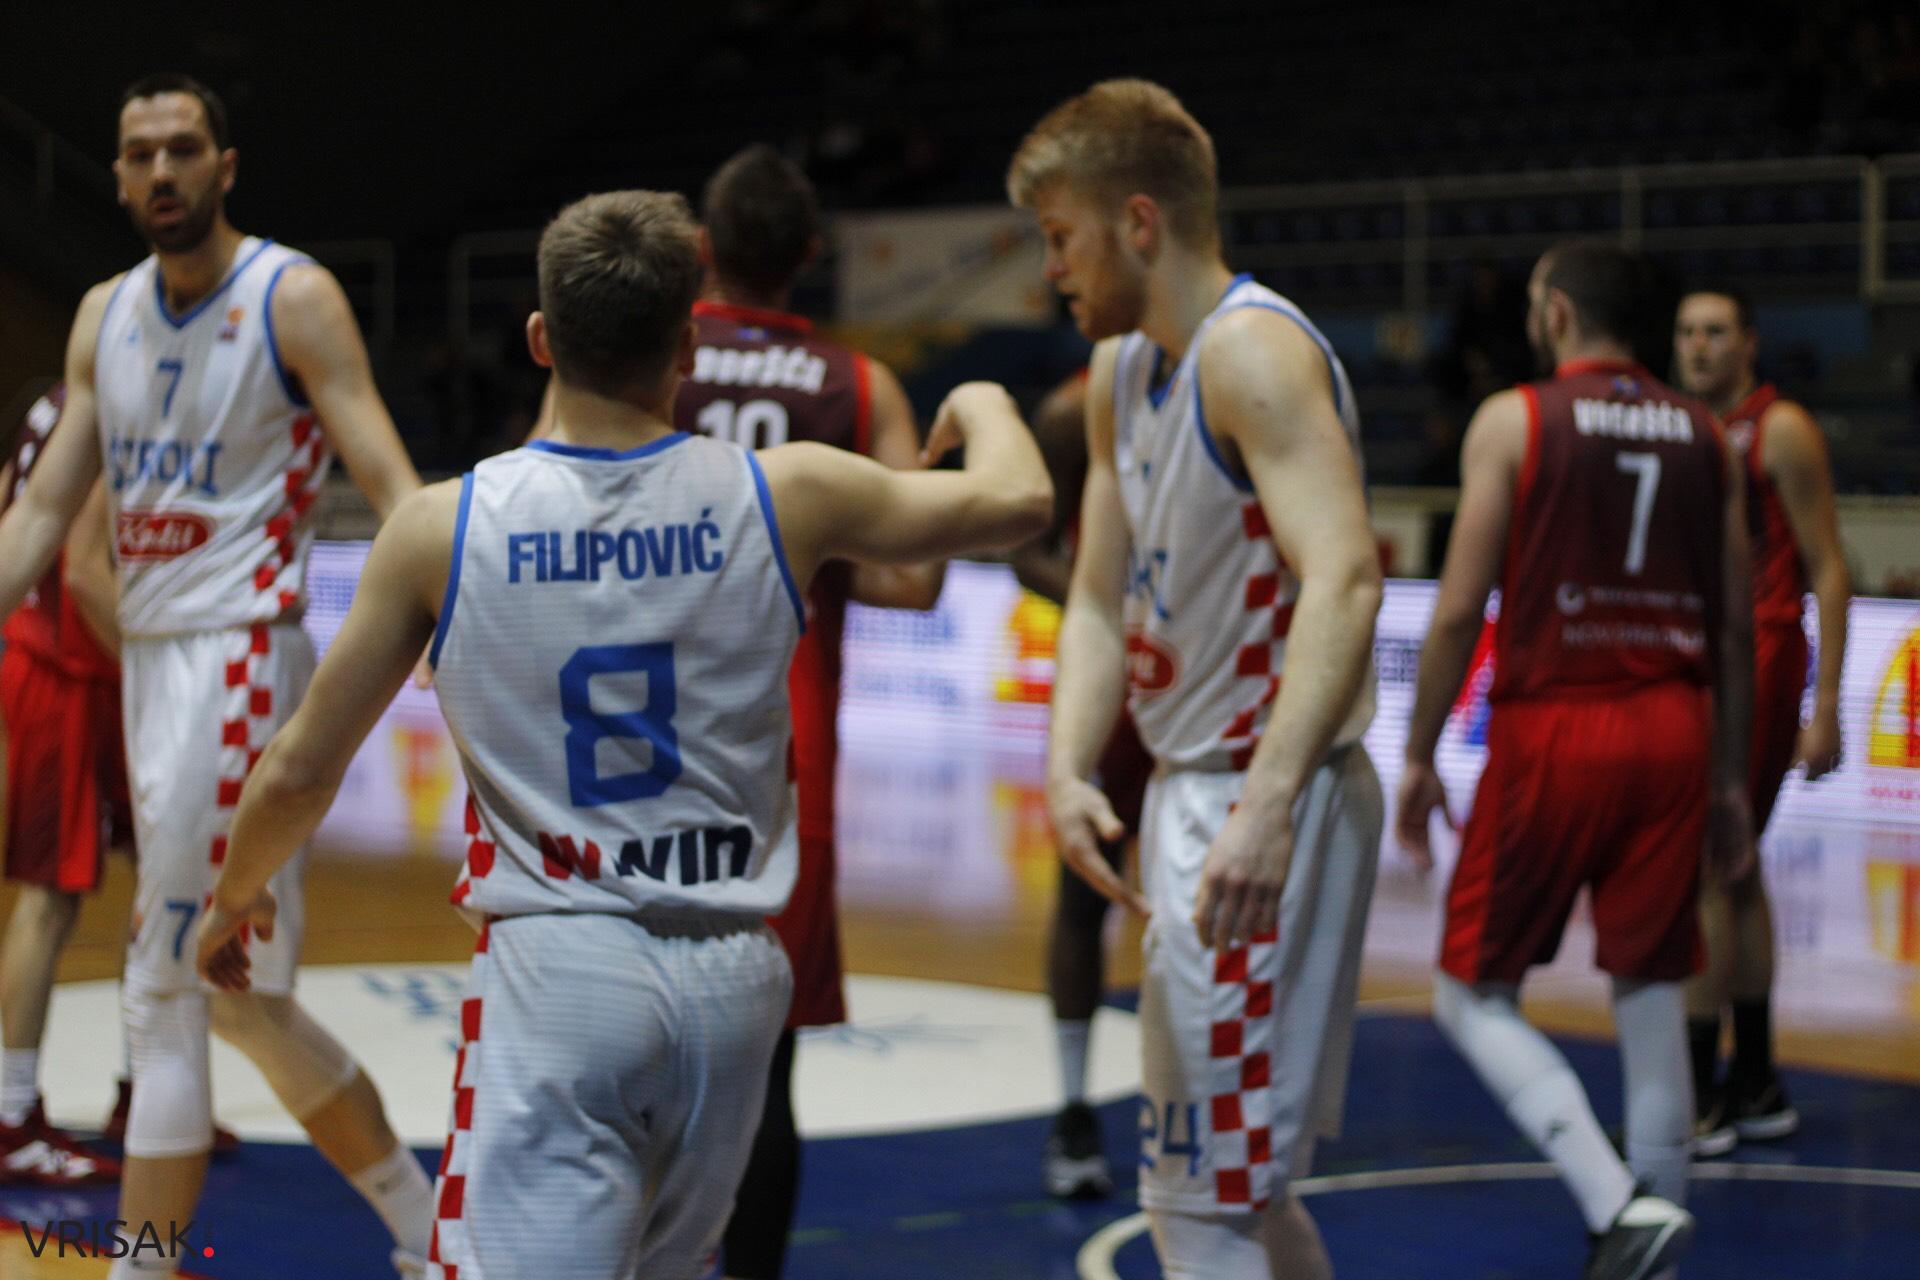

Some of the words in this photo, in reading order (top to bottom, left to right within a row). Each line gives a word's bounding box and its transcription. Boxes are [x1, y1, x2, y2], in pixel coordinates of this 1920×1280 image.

[157, 359, 183, 418] 7
[507, 507, 723, 584] FILIPOVIĆ
[1614, 450, 1661, 576] 7
[558, 640, 682, 808] 8
[165, 899, 197, 961] 7
